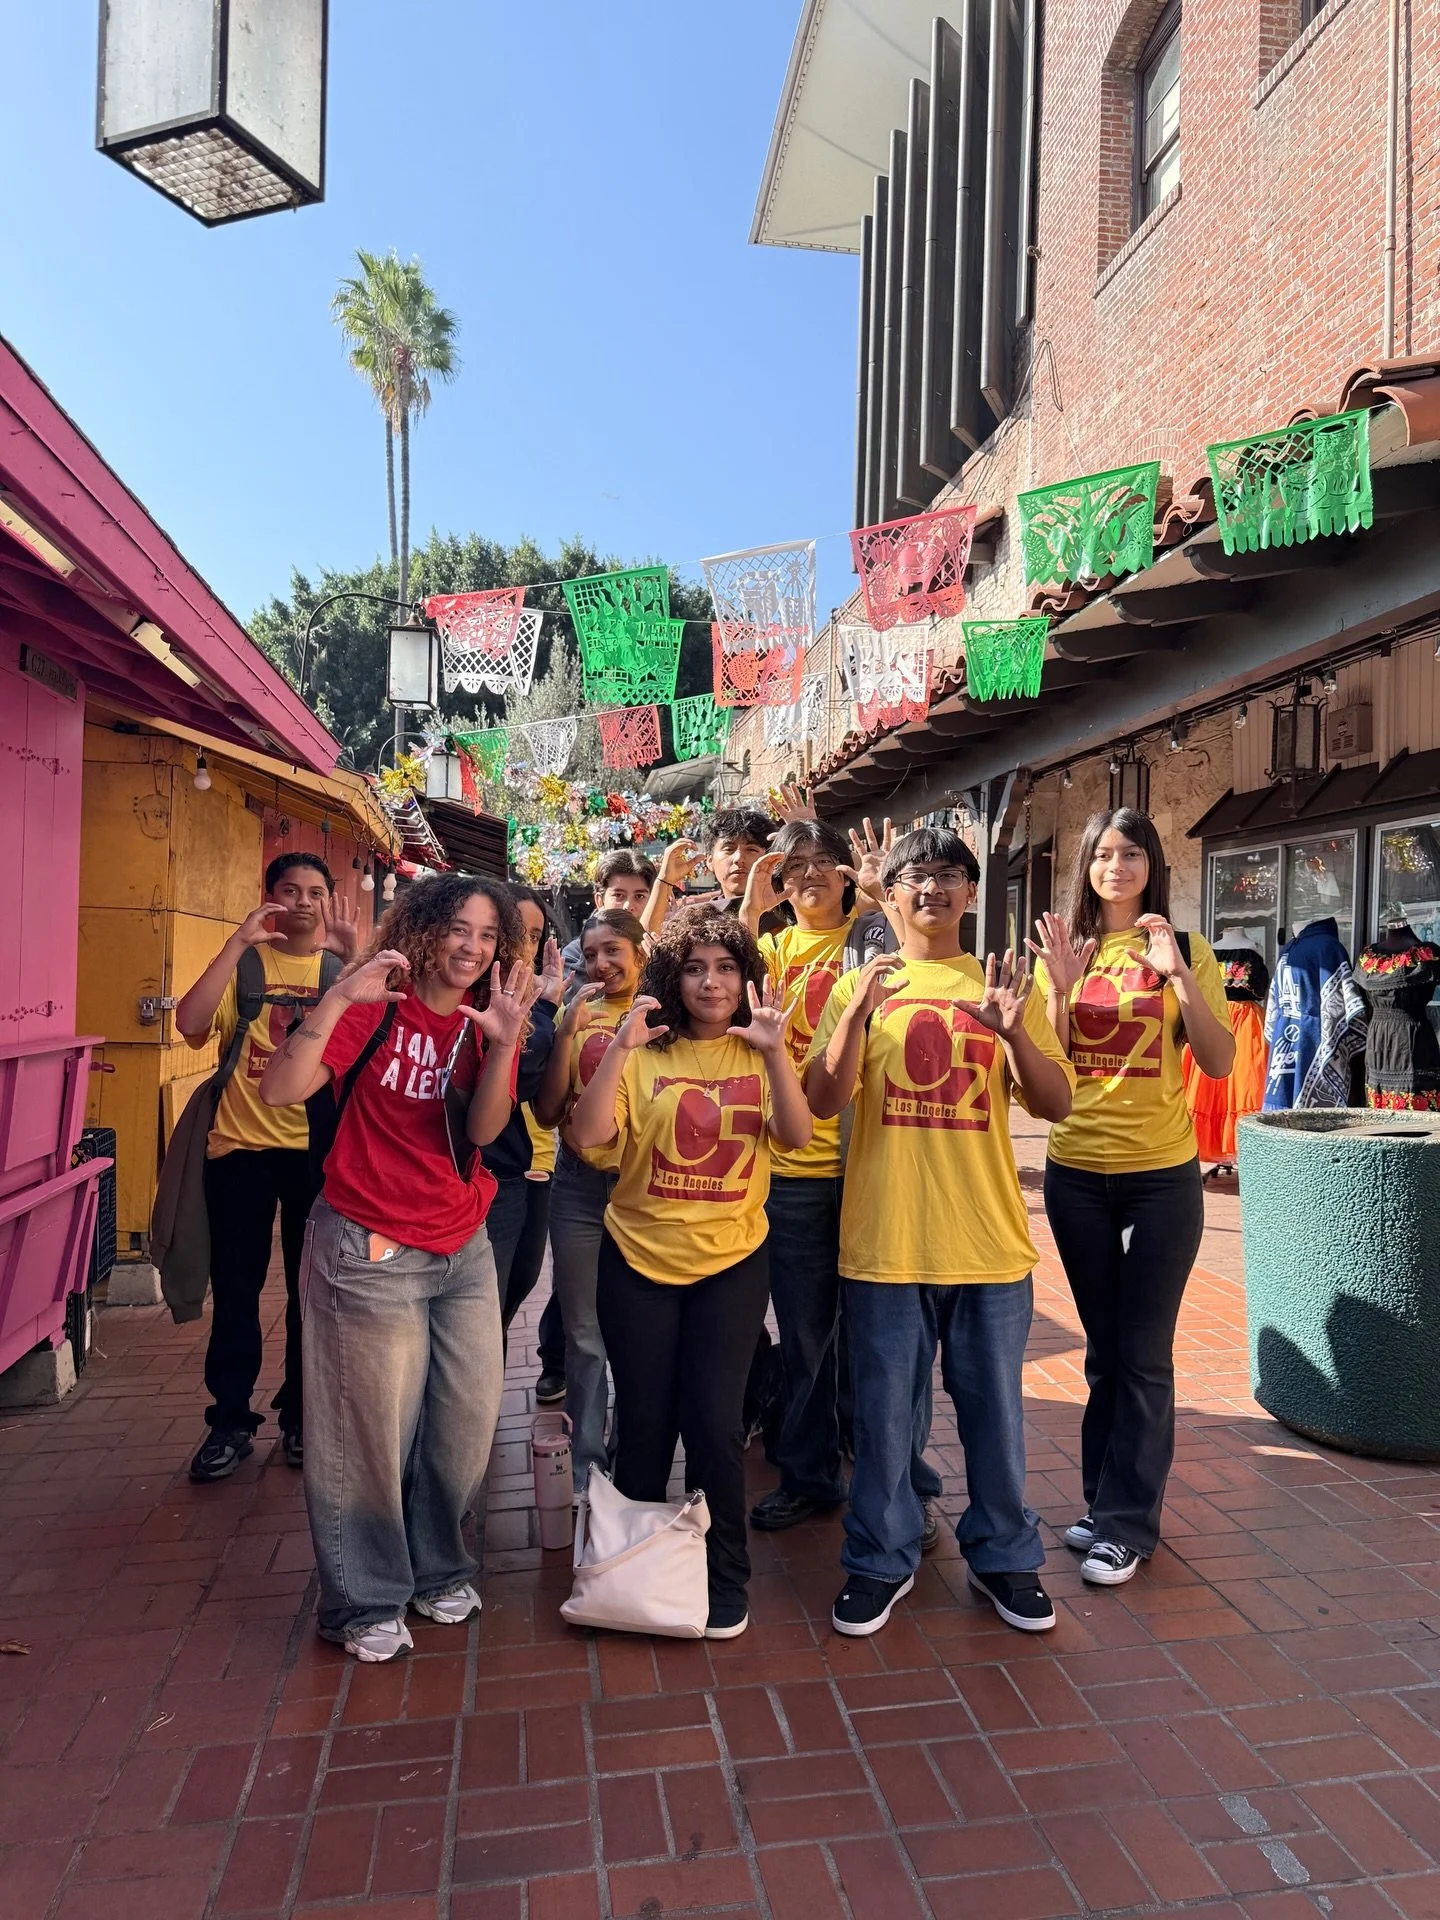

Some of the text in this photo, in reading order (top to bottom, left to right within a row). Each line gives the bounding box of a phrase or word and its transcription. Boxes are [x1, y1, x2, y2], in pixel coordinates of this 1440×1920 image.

[394, 1026, 404, 1053] I
[1073, 1051, 1127, 1067] Los Angeles
[380, 1057, 400, 1091] A
[895, 1098, 957, 1118] Los Angeles
[662, 1172, 724, 1190] Los Angeles
